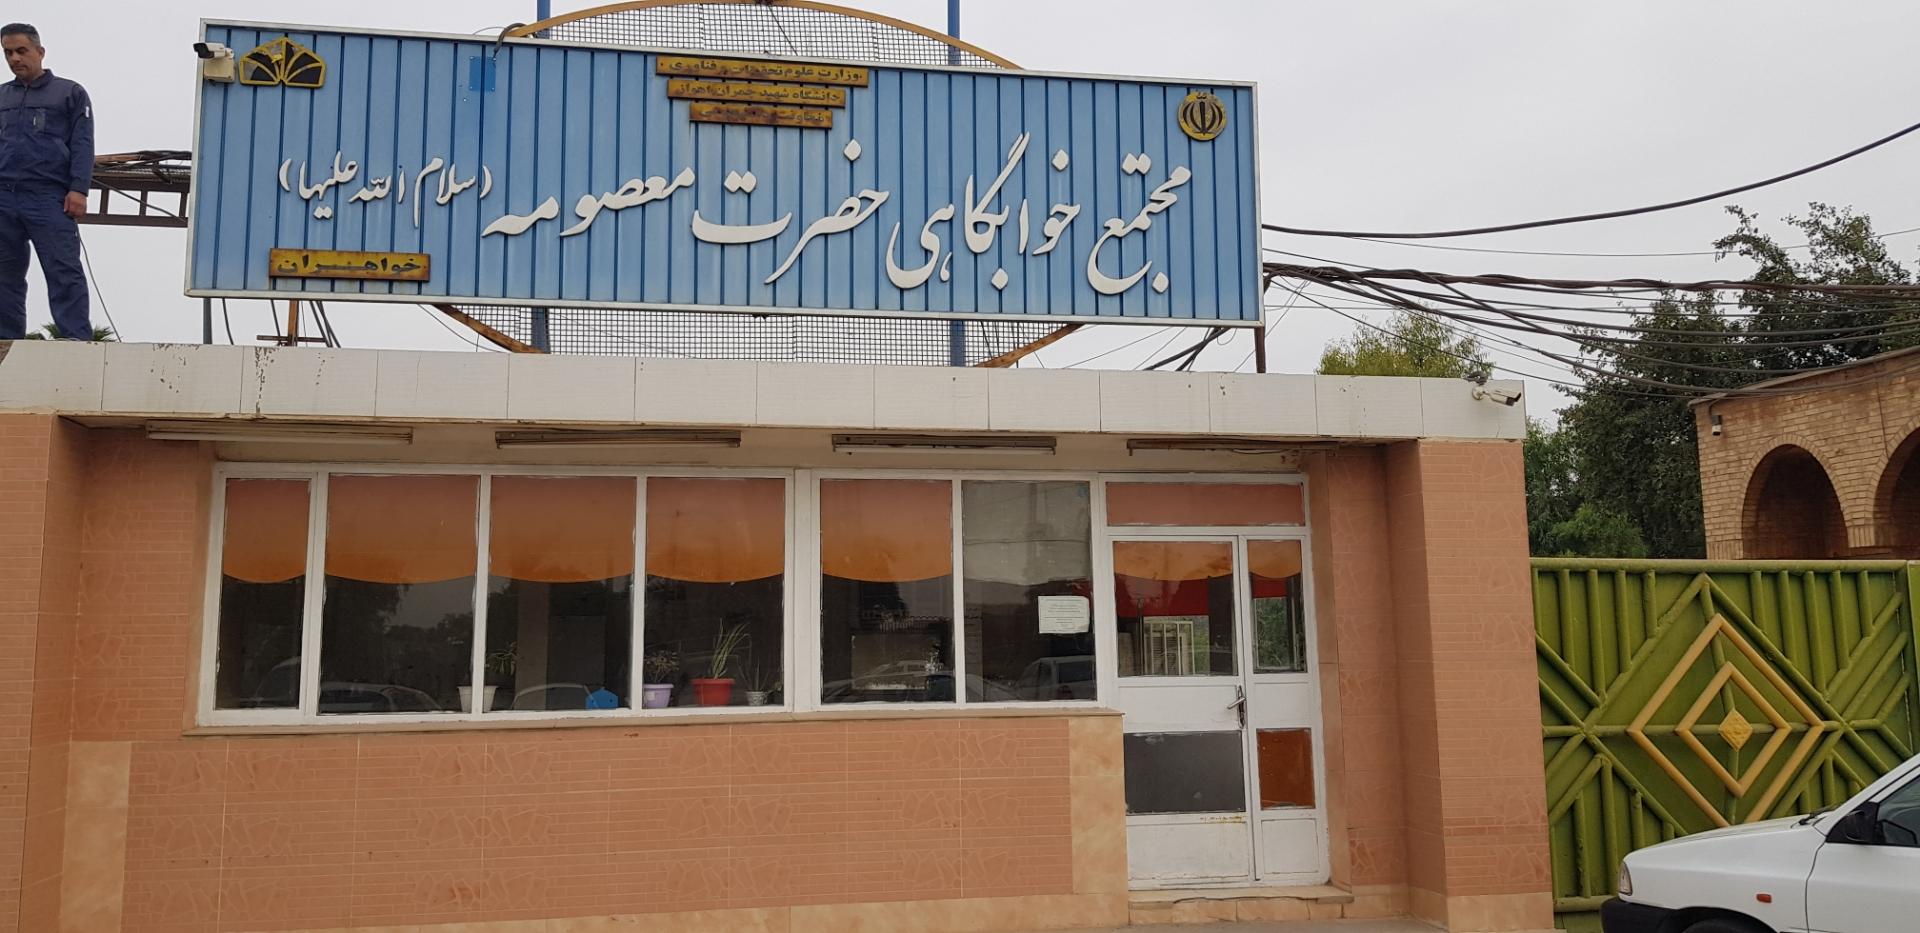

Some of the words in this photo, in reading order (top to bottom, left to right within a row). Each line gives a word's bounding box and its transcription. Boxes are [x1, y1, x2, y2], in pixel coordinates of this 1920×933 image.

[783, 66, 814, 79] علوم
[816, 69, 861, 81] وزارت
[759, 88, 790, 101] شهید
[792, 88, 840, 101] دانشگاه
[481, 166, 697, 239] معصومه
[691, 138, 891, 286] حضرت
[886, 131, 1081, 290] خوابگاهی
[1087, 152, 1192, 294] مجتمع
[277, 254, 422, 276] خواهران
